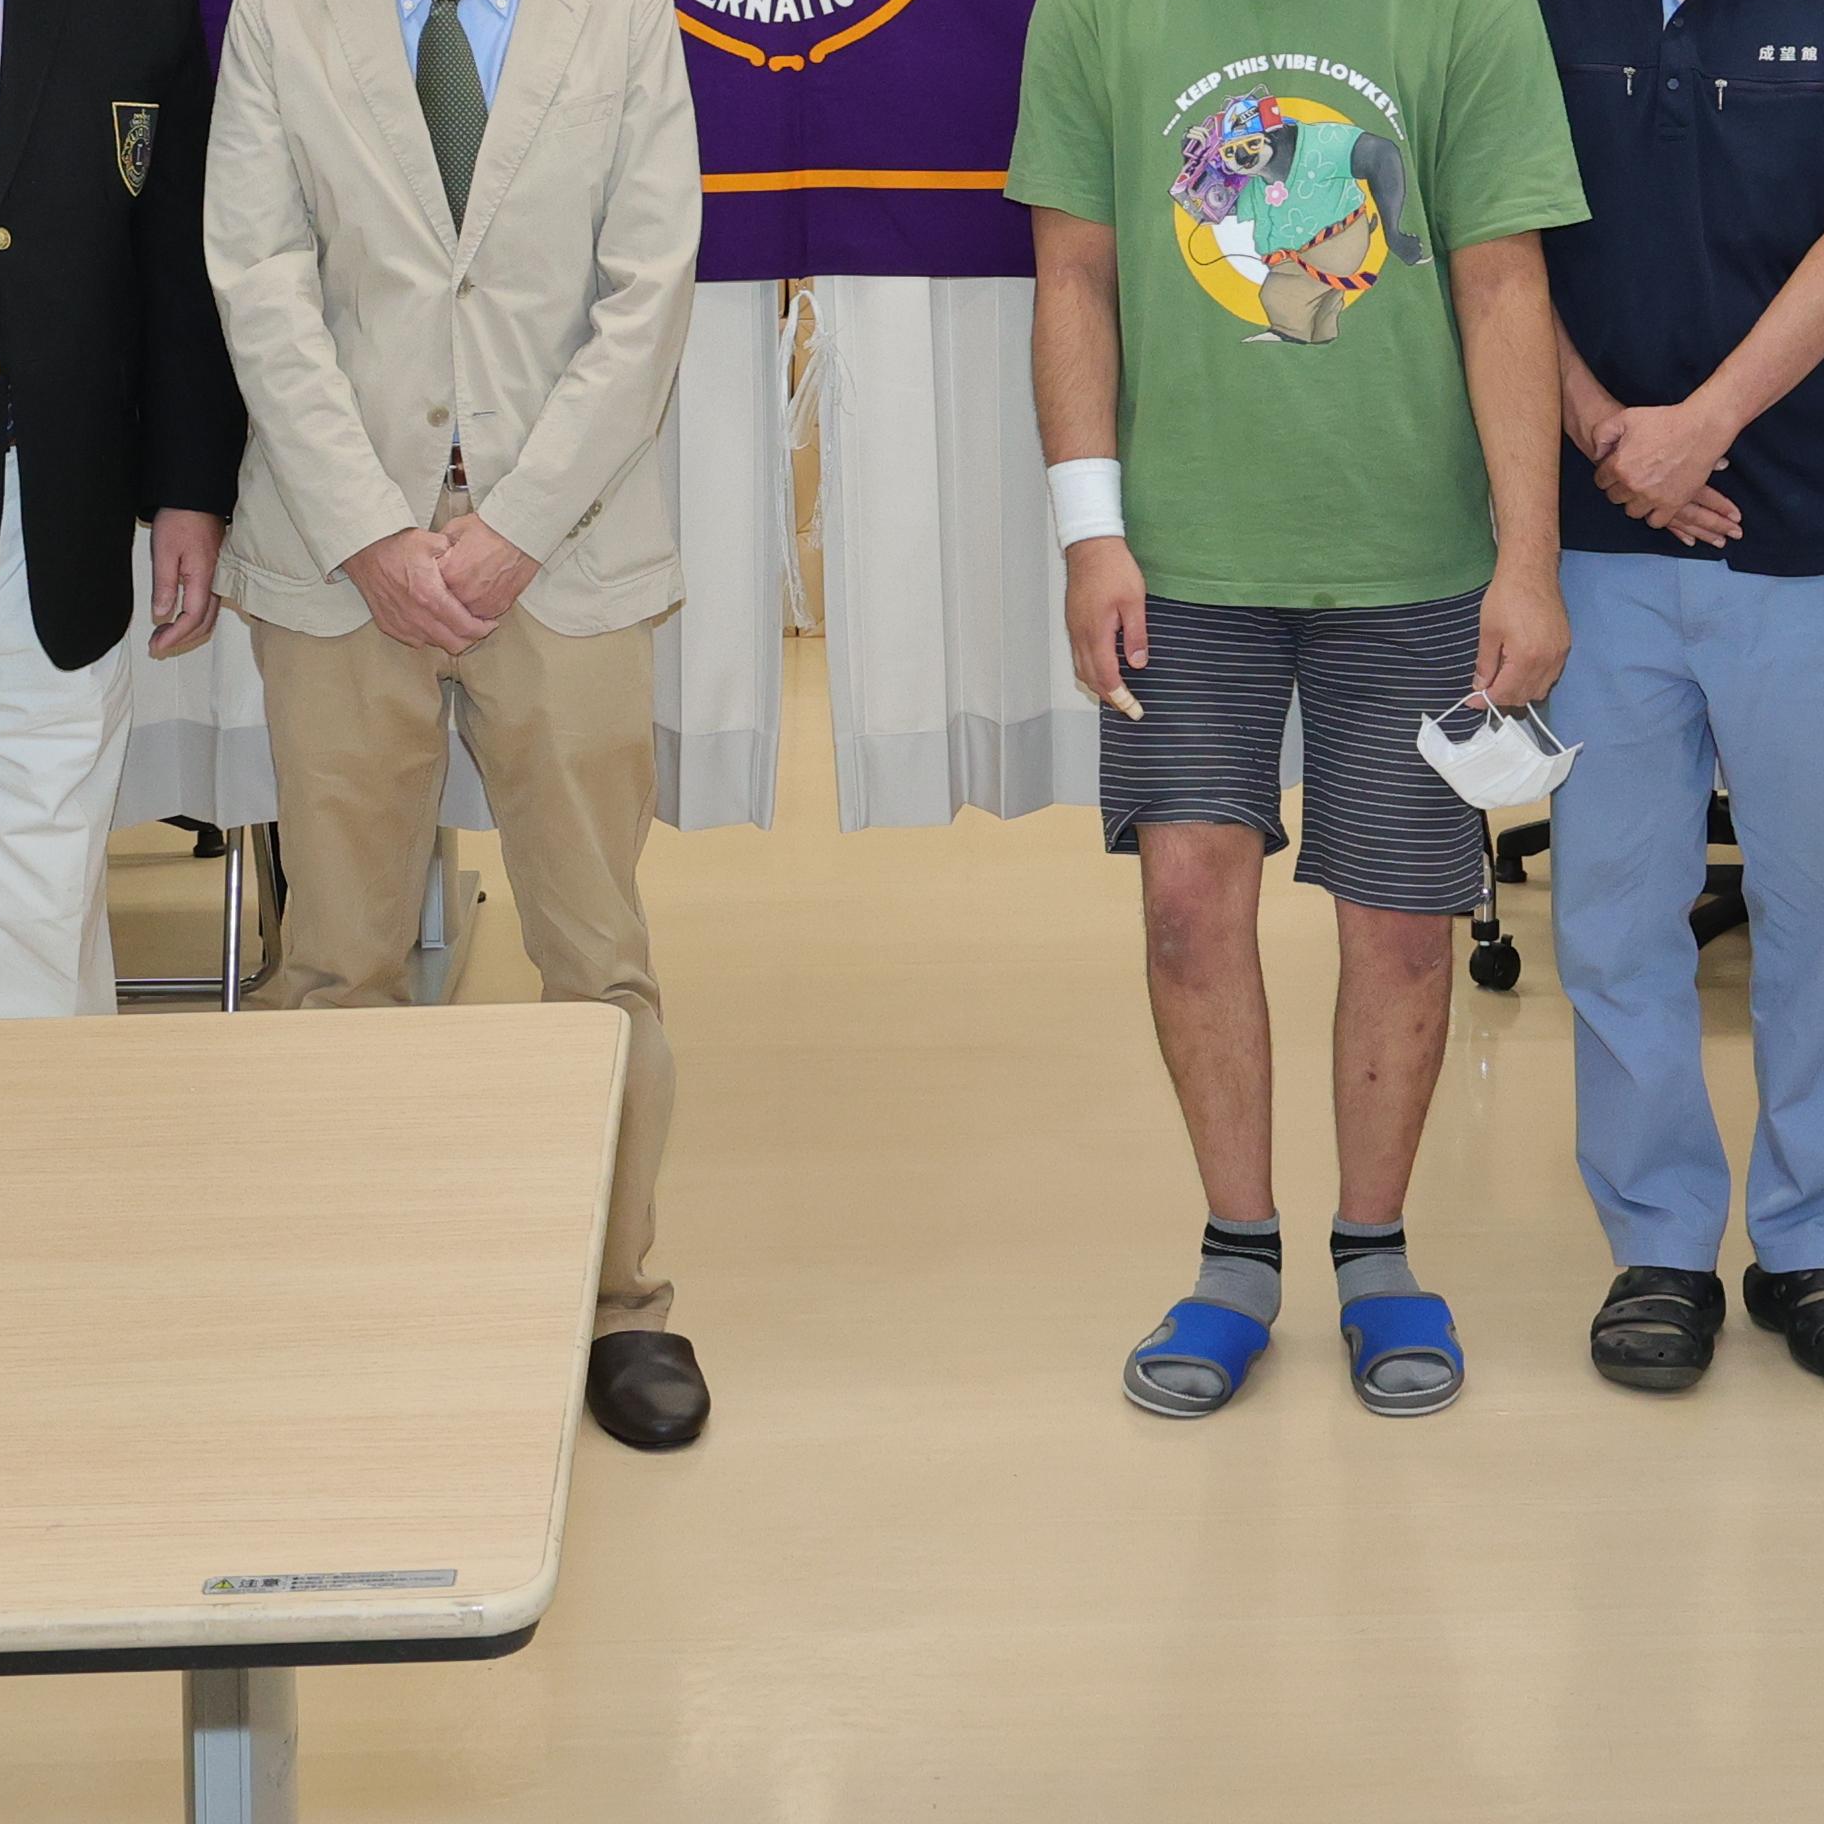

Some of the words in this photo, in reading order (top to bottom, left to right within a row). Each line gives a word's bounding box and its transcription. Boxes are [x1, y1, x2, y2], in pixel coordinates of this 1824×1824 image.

[1758, 45, 1818, 61] 成望館
[1223, 55, 1269, 80] THIS
[1271, 53, 1316, 71] VIBE
